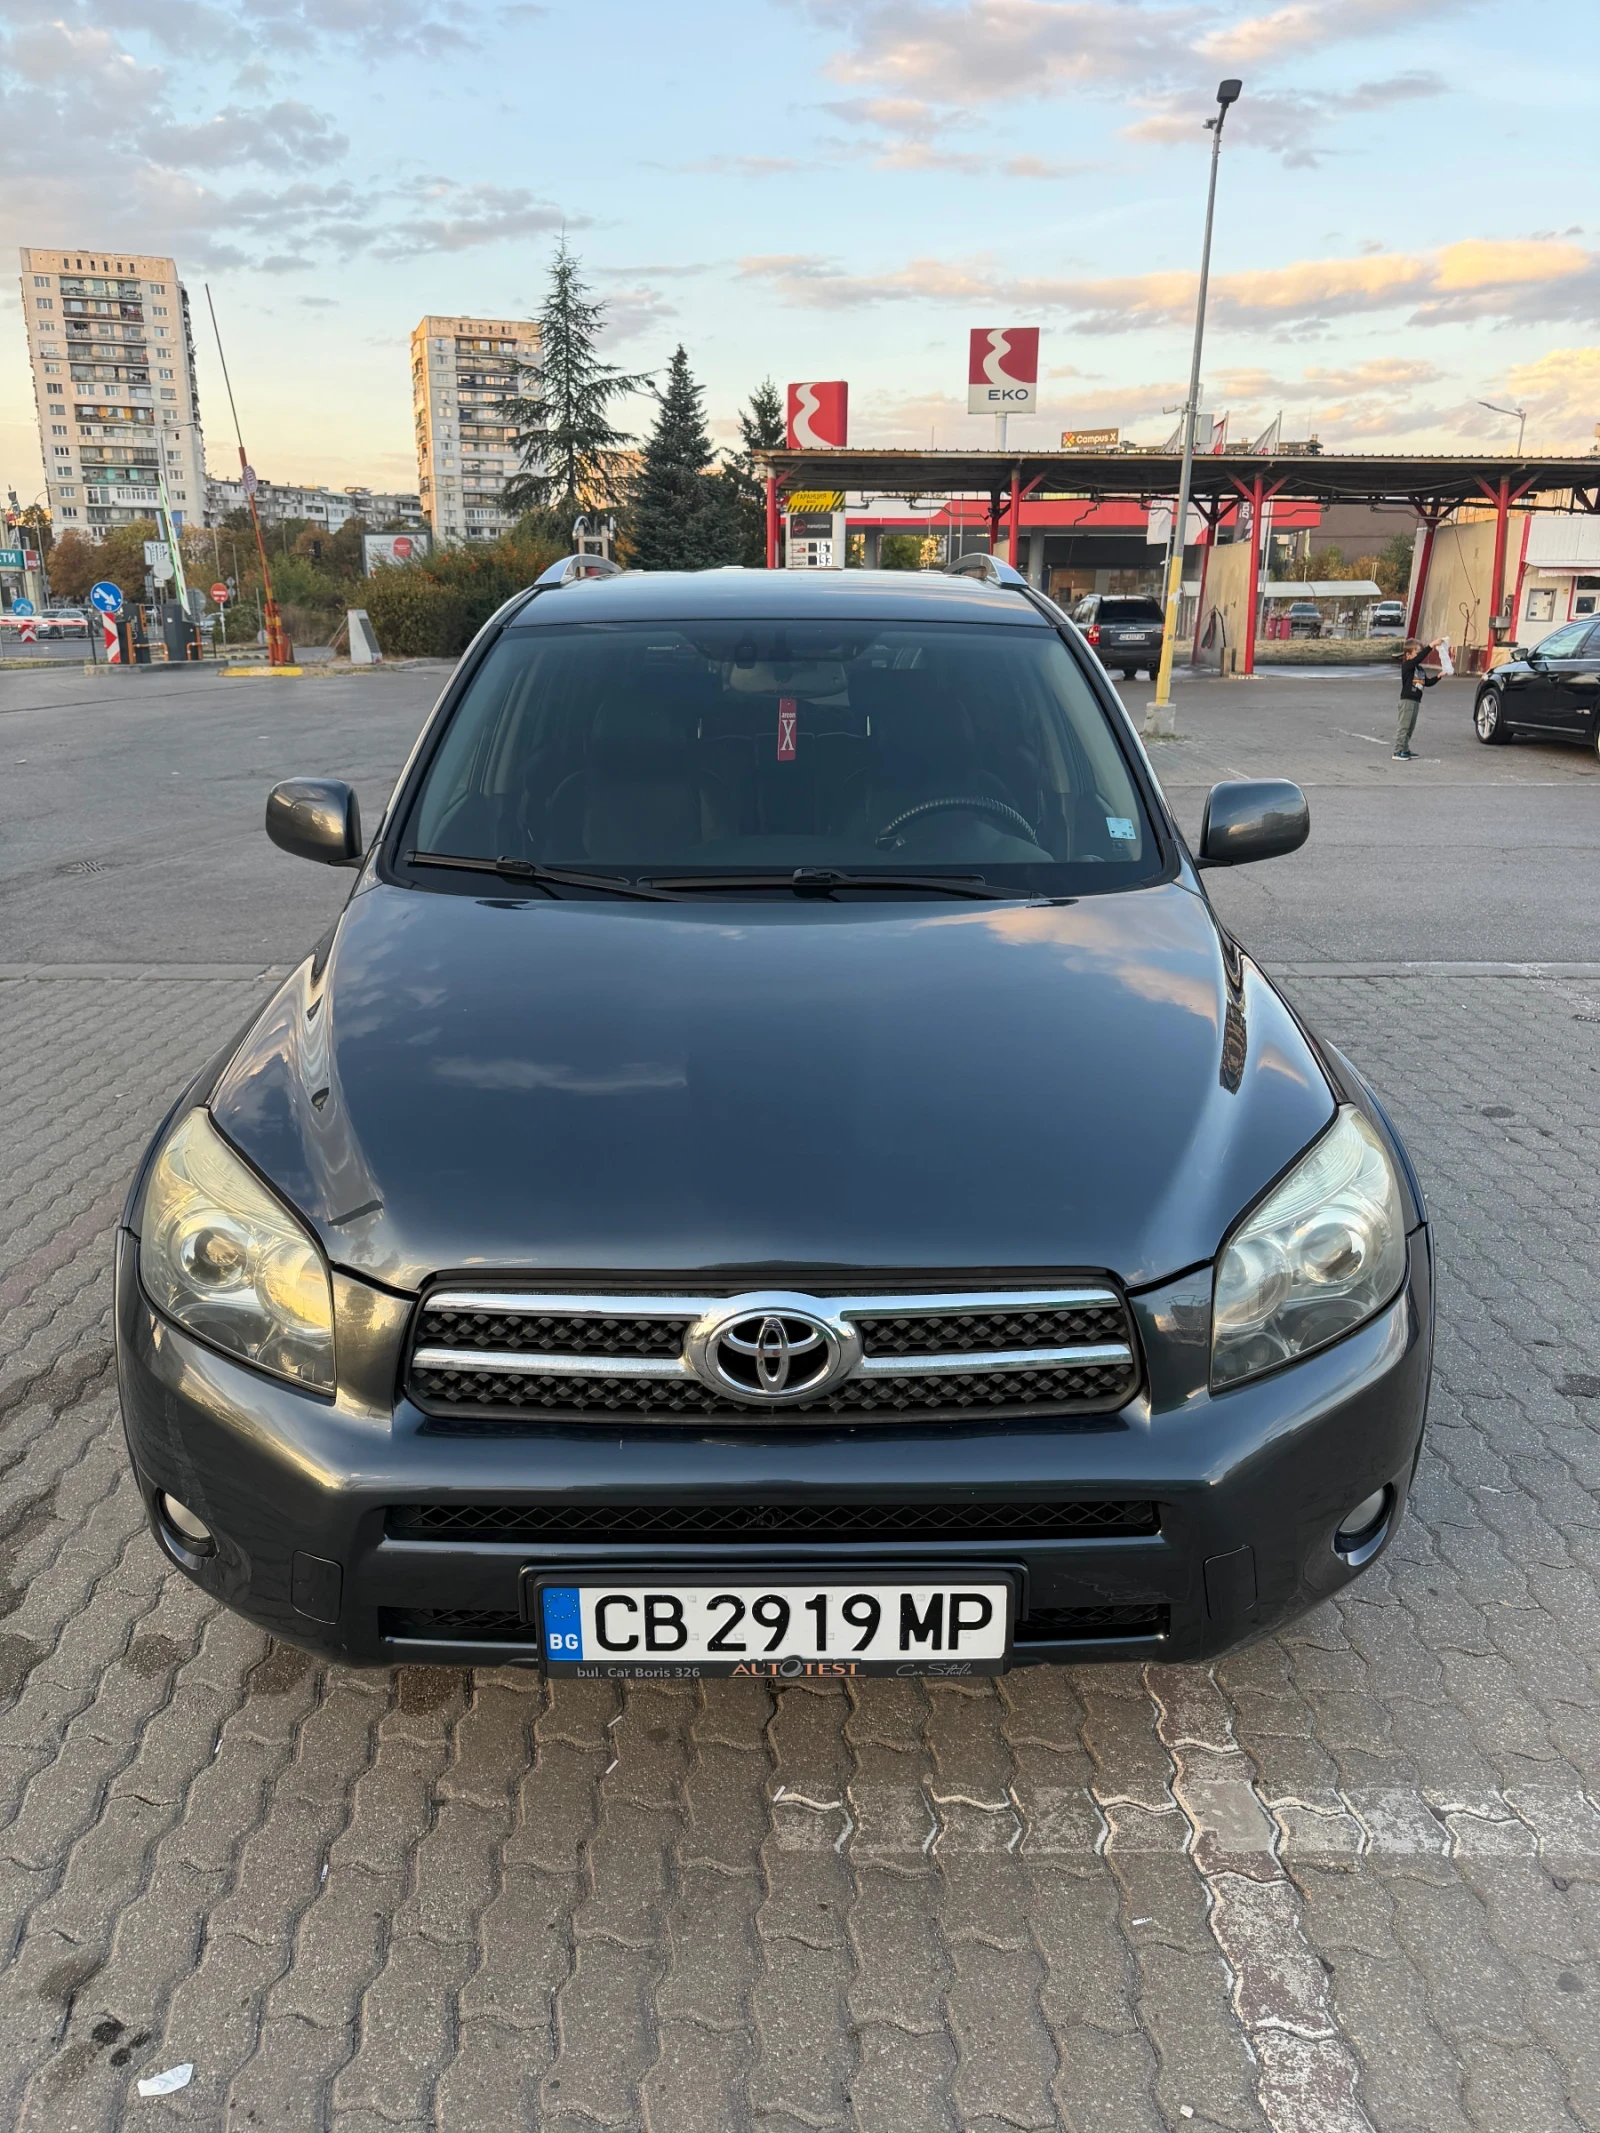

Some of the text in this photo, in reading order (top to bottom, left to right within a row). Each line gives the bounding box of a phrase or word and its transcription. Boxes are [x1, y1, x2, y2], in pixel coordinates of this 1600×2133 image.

[988, 389, 1028, 400] EKO
[1076, 432, 1117, 445] Campus X
[780, 719, 796, 751] X
[595, 1593, 993, 1652] CB 2919 MP
[550, 1633, 579, 1650] BG
[576, 1667, 701, 1678] bul. Car Boris 326
[732, 1657, 862, 1677] AUTOTEST
